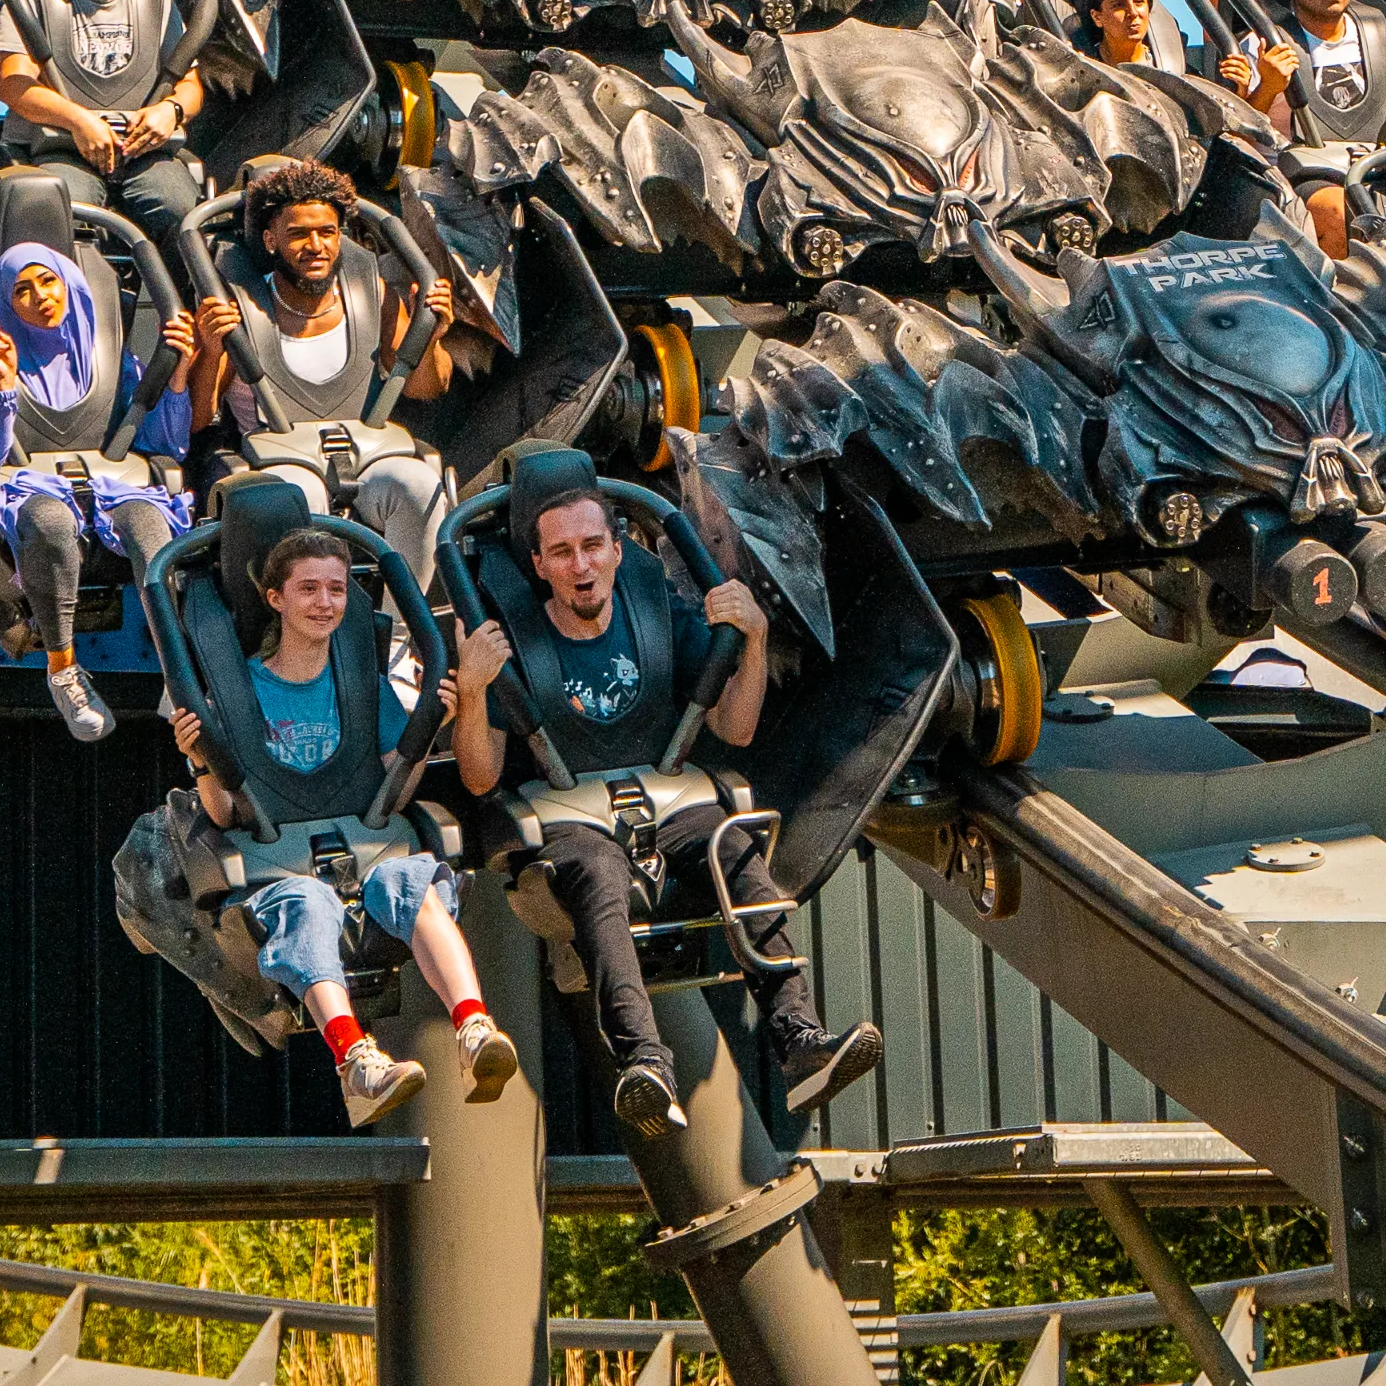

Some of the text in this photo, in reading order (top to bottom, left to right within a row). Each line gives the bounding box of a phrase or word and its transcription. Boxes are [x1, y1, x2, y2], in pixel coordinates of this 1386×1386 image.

[1114, 244, 1287, 276] THORPE
[1147, 263, 1278, 293] PARK
[1312, 567, 1333, 605] 1
